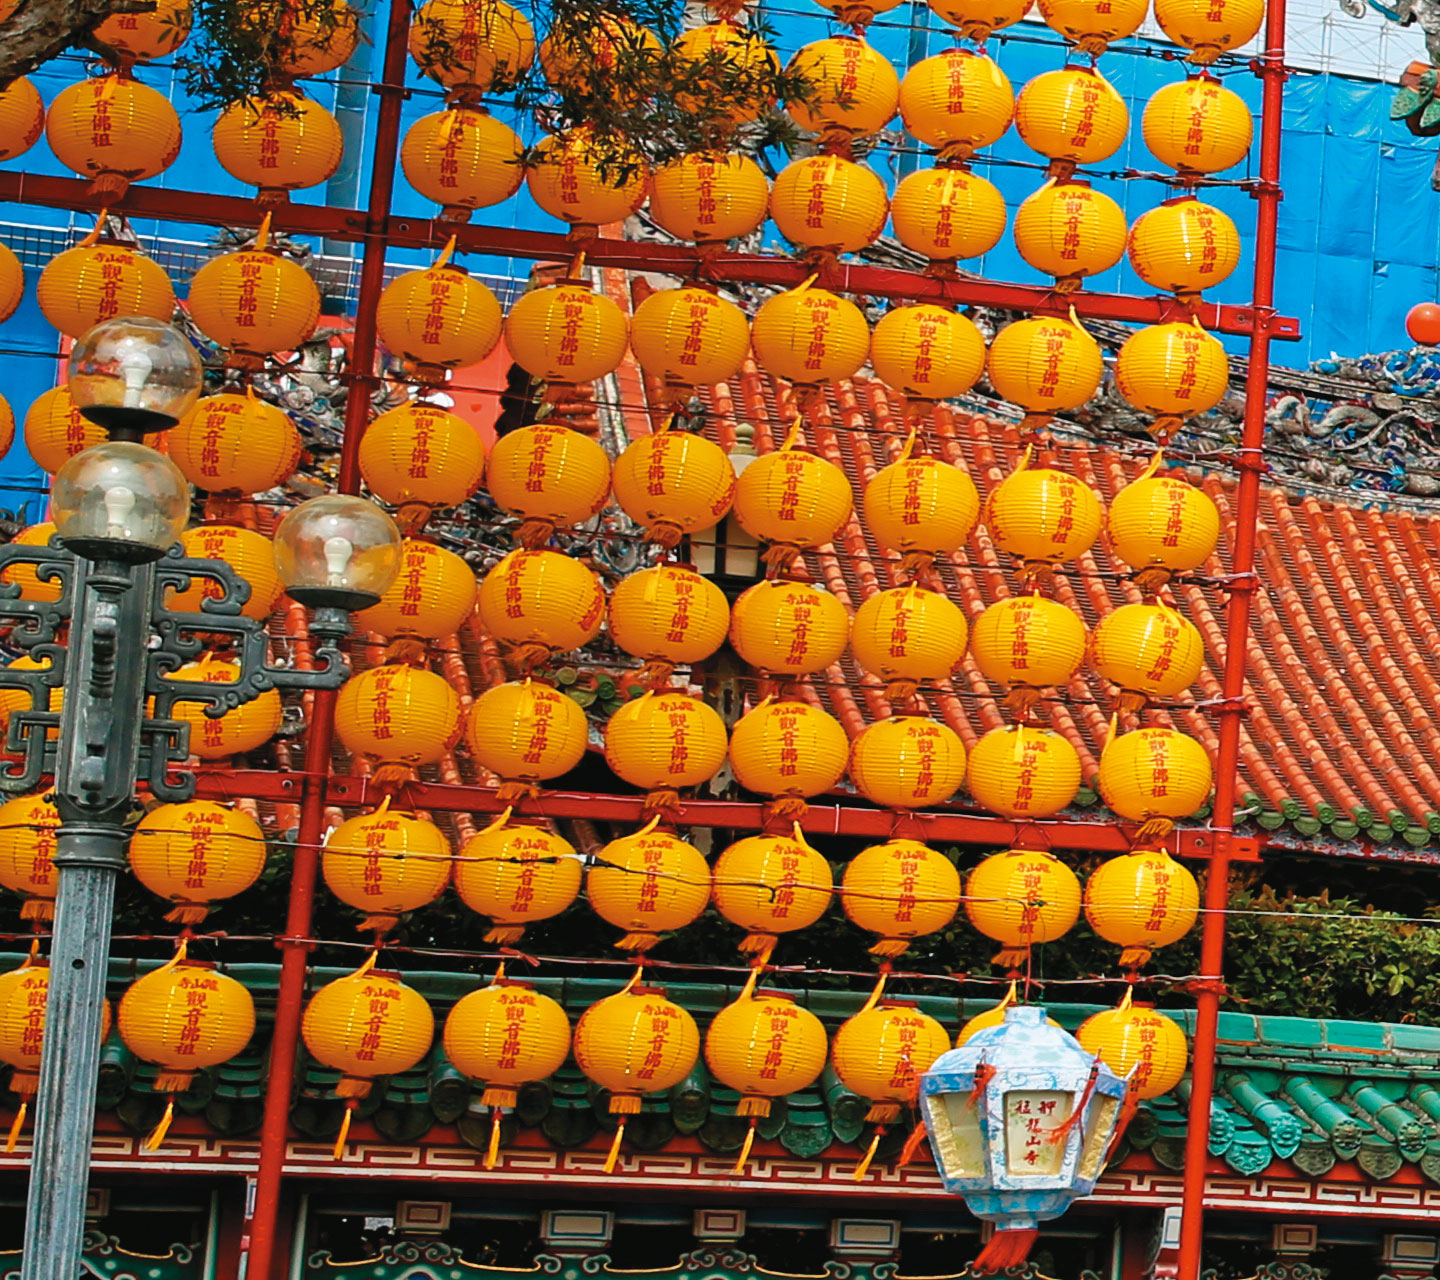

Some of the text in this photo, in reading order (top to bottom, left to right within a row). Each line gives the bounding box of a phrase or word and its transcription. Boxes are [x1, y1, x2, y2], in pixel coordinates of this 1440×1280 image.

[945, 60, 965, 113] 觀音佛祖
[1070, 93, 1098, 147] 觀音佛祖
[696, 165, 716, 223] 觀音佛祖
[1060, 201, 1081, 259] 觀音佛祖
[1198, 217, 1216, 273] 觀音佛祖
[234, 263, 260, 326] 觀音佛祖
[423, 281, 451, 344] 觀音佛祖
[557, 304, 583, 365] 觀音佛祖
[676, 304, 701, 364] 觀音佛祖
[804, 310, 828, 370] 觀音佛祖
[913, 324, 935, 383] 觀音佛祖
[1038, 339, 1063, 397] 觀音佛祖
[1173, 341, 1200, 398] 觀音佛祖
[199, 409, 225, 476] 觀音佛祖
[407, 418, 434, 478] 觀音佛祖
[524, 436, 551, 492] 觀音佛祖
[647, 436, 669, 495] 觀音佛祖
[777, 462, 802, 520] 觀音佛祖
[902, 467, 924, 525] 觀音佛祖
[1050, 485, 1074, 543] 觀音佛祖
[1160, 487, 1183, 546] 觀音佛祖
[399, 554, 425, 615] 觀音佛祖
[665, 581, 692, 642] 觀音佛祖
[784, 607, 811, 665] 觀音佛祖
[1010, 611, 1031, 669] 觀音佛祖
[1146, 626, 1178, 680] 觀音佛祖
[522, 703, 552, 763] 觀音佛祖
[666, 714, 689, 773] 觀音佛祖
[777, 716, 798, 775] 觀音佛祖
[911, 740, 937, 797] 觀音佛祖
[1150, 740, 1168, 796] 觀音佛祖
[185, 823, 211, 888] 觀音佛祖
[1143, 870, 1169, 931] 觀音佛祖
[22, 991, 45, 1054] 觀音佛祖
[175, 990, 206, 1054] 觀音佛祖
[351, 998, 387, 1061] 觀音佛祖
[497, 1004, 525, 1068] 觀音佛祖
[637, 1017, 668, 1079] 觀音佛祖
[758, 1019, 787, 1080] 觀音佛祖
